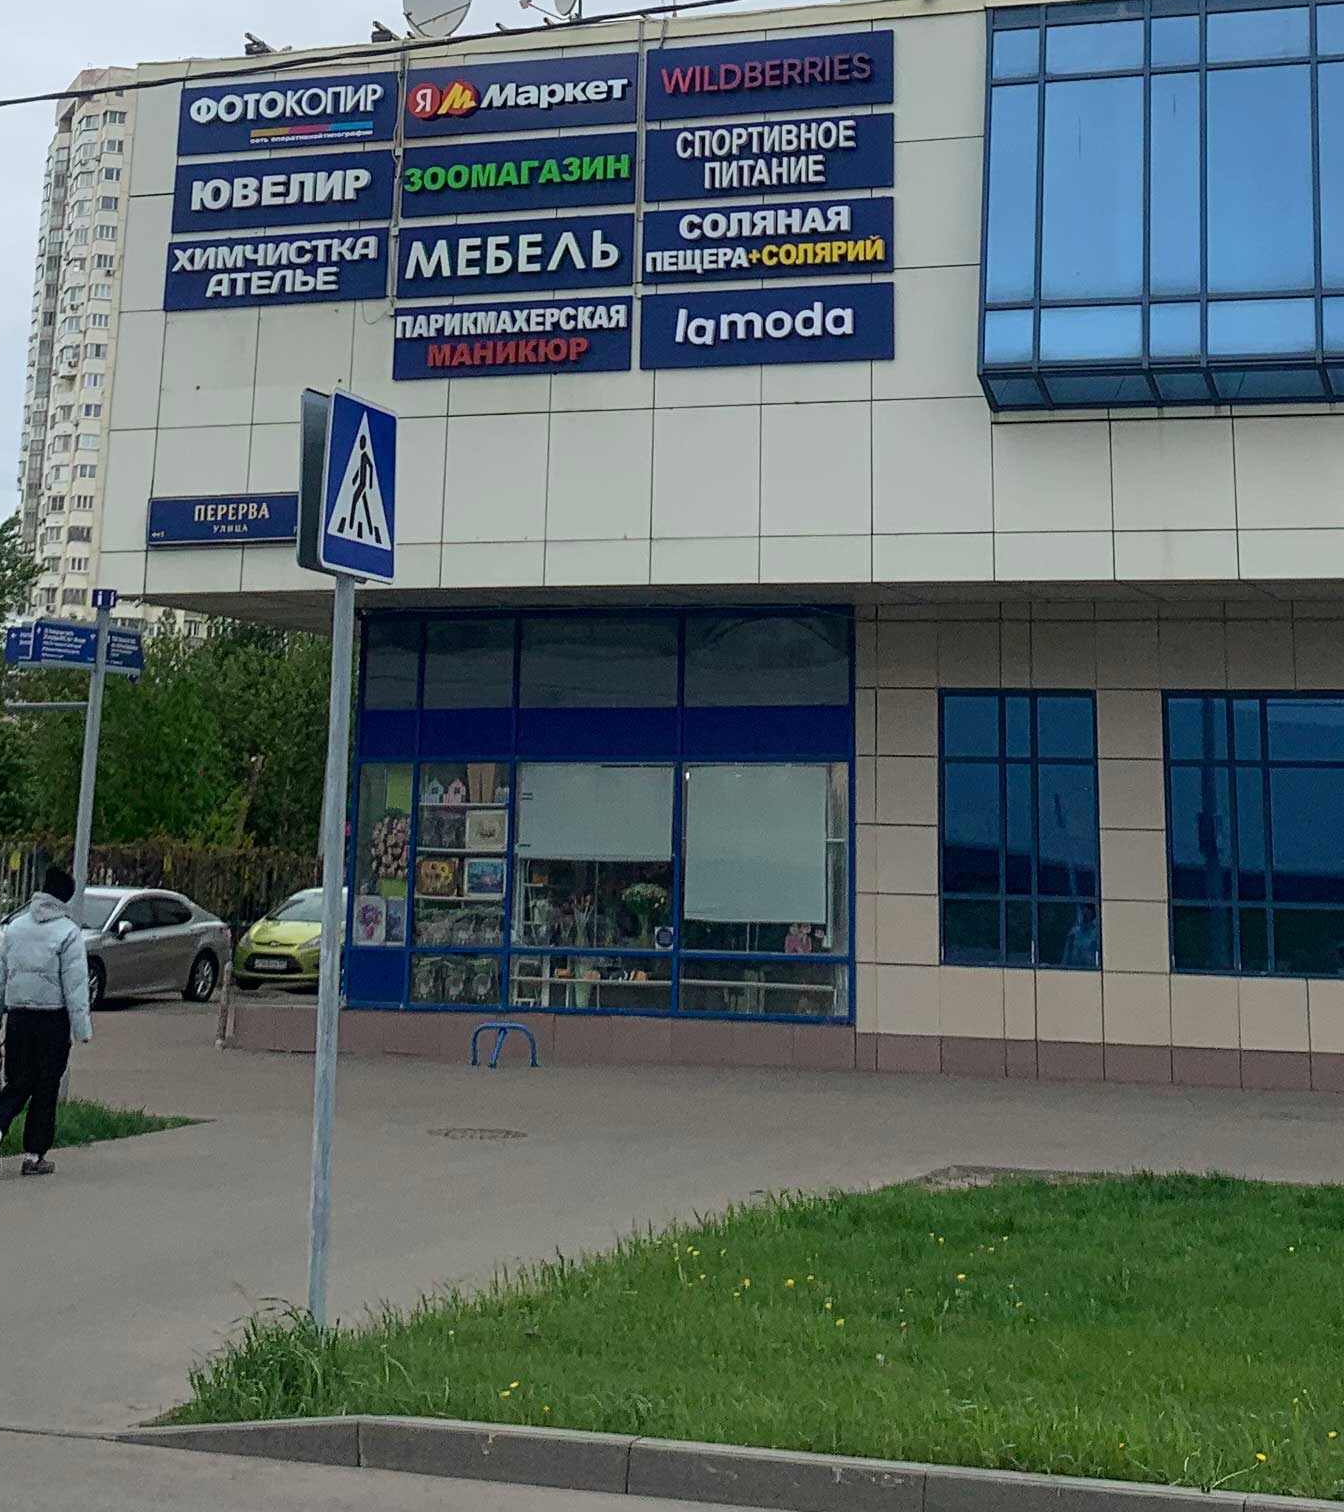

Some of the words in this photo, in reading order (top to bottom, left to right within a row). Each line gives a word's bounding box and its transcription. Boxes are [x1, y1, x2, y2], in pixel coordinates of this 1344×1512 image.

[661, 52, 872, 94] WILDBERRIES
[189, 84, 385, 123] ФОТОКОПИР
[480, 78, 629, 109] Маркет
[676, 120, 856, 159] СПОРТИВНОЕ
[191, 168, 372, 212] ЮВЕЛИР
[404, 154, 630, 193] ЗООМАГАЗИН
[703, 154, 826, 190] ПИТАНИЕ
[679, 205, 852, 240] СОЛЯНАЯ
[172, 236, 379, 272] ХИМЧИСТКА
[405, 230, 620, 280] МЕБЕЛЬ
[206, 266, 340, 298] АТЕЛЬЕ
[395, 304, 628, 338] ПАРИКМАХЕРСКАЯ
[675, 301, 854, 345] lamoda
[427, 337, 590, 368] МАНИКЮР
[194, 502, 270, 522] ПЕРЕРВА
[213, 524, 249, 534] УЛИЦА
